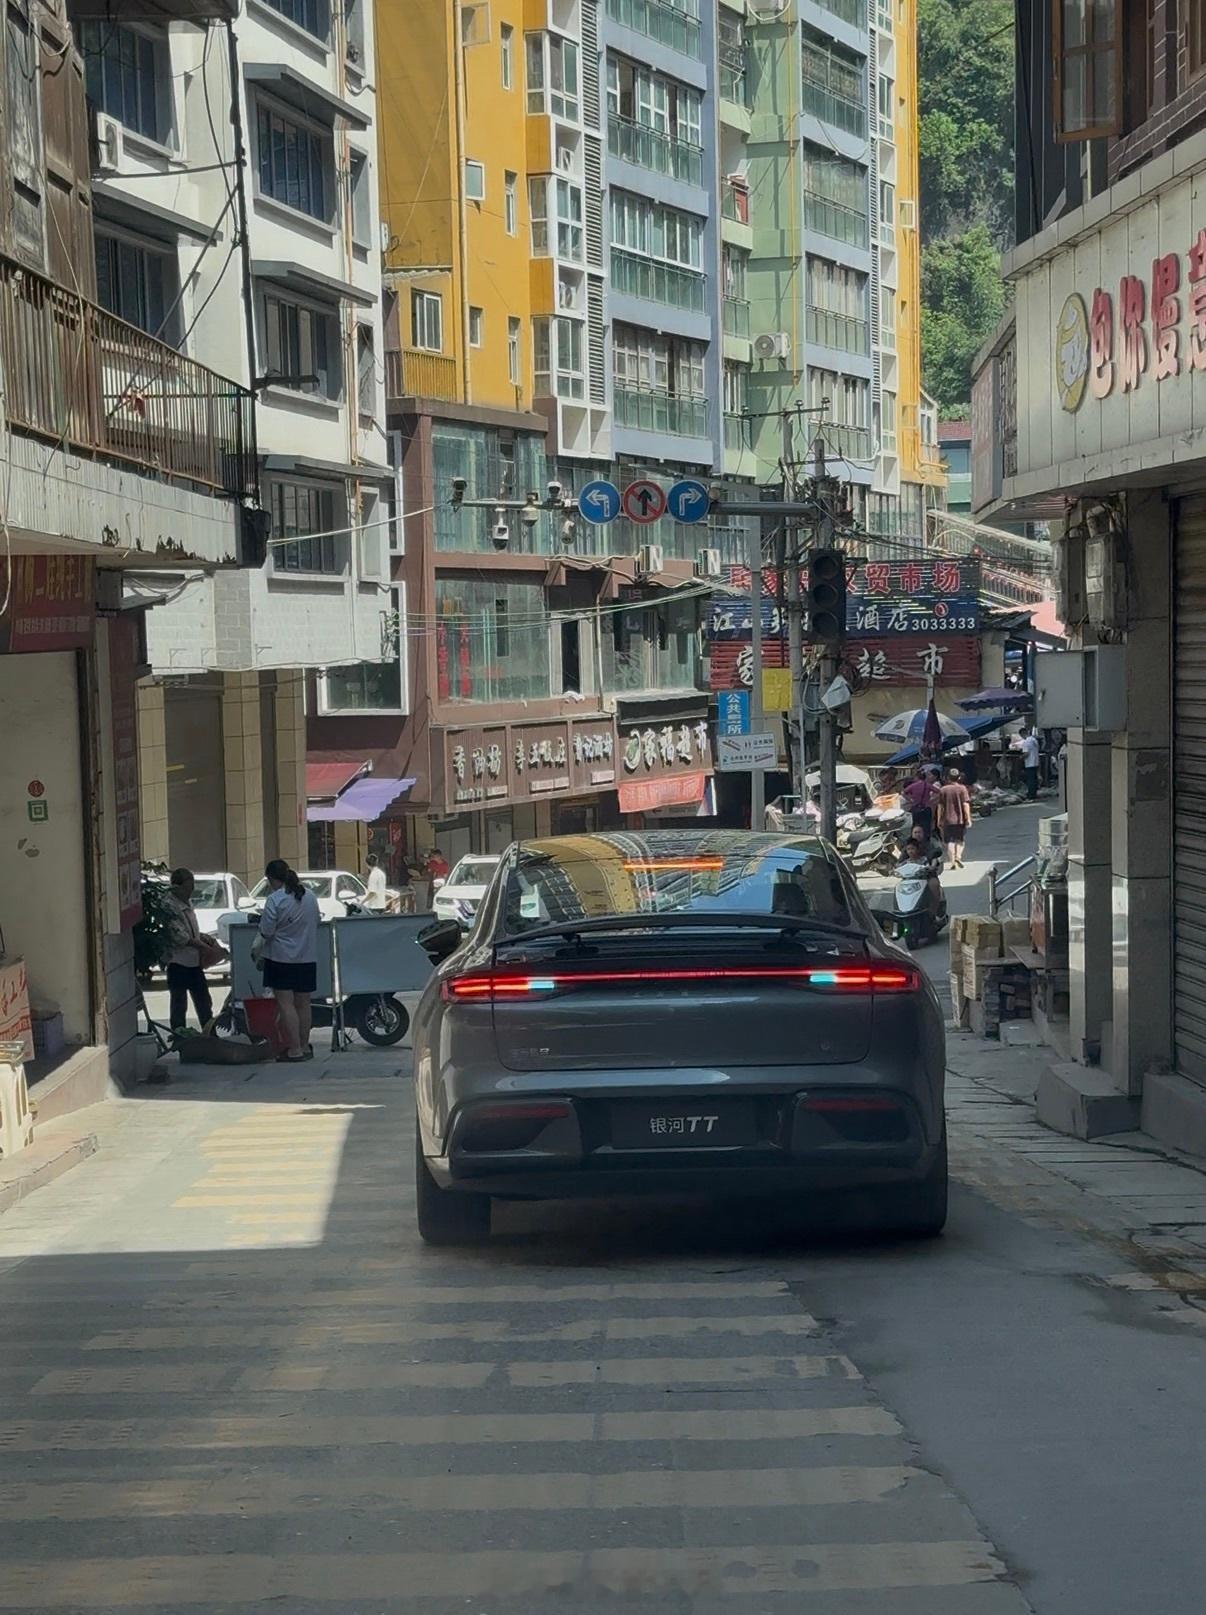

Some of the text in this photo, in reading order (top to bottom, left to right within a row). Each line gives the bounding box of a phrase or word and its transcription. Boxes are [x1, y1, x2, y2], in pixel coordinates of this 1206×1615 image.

[911, 617, 976, 631] 3033333
[736, 642, 949, 687] 家超市
[649, 1115, 719, 1134] 银河TT
